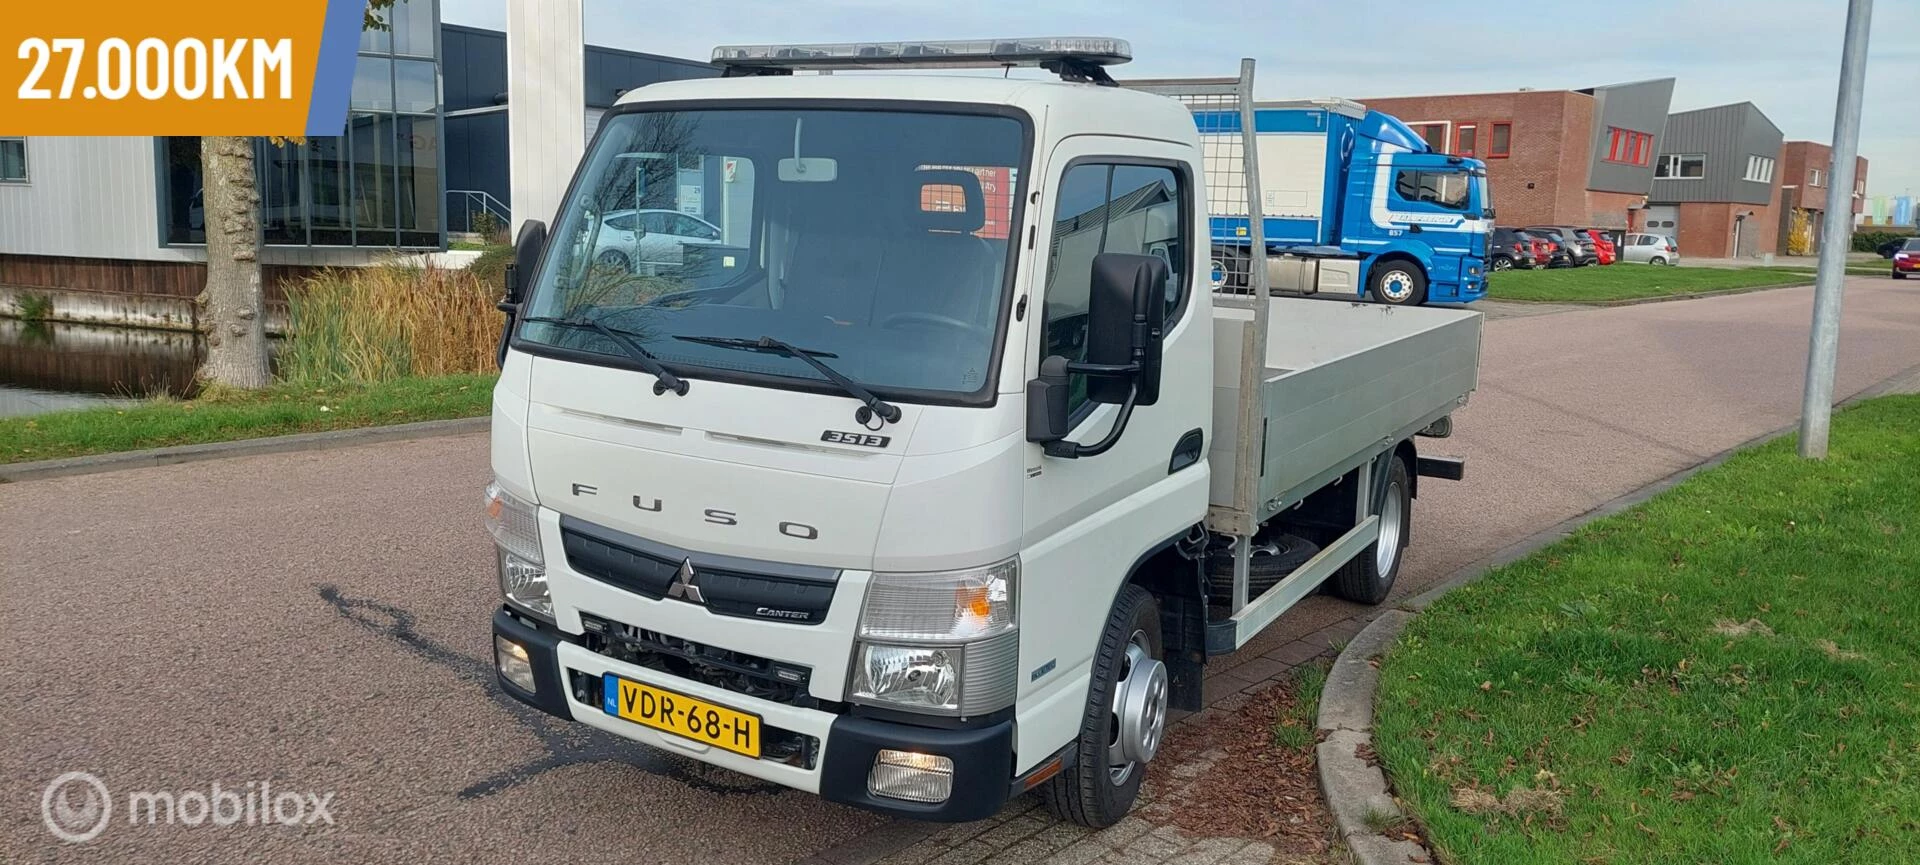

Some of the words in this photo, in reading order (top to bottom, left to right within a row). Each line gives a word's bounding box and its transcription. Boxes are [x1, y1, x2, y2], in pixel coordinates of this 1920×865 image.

[572, 483, 818, 540] FUSO
[607, 697, 617, 708] NL
[623, 685, 750, 749] VDR-68-H
